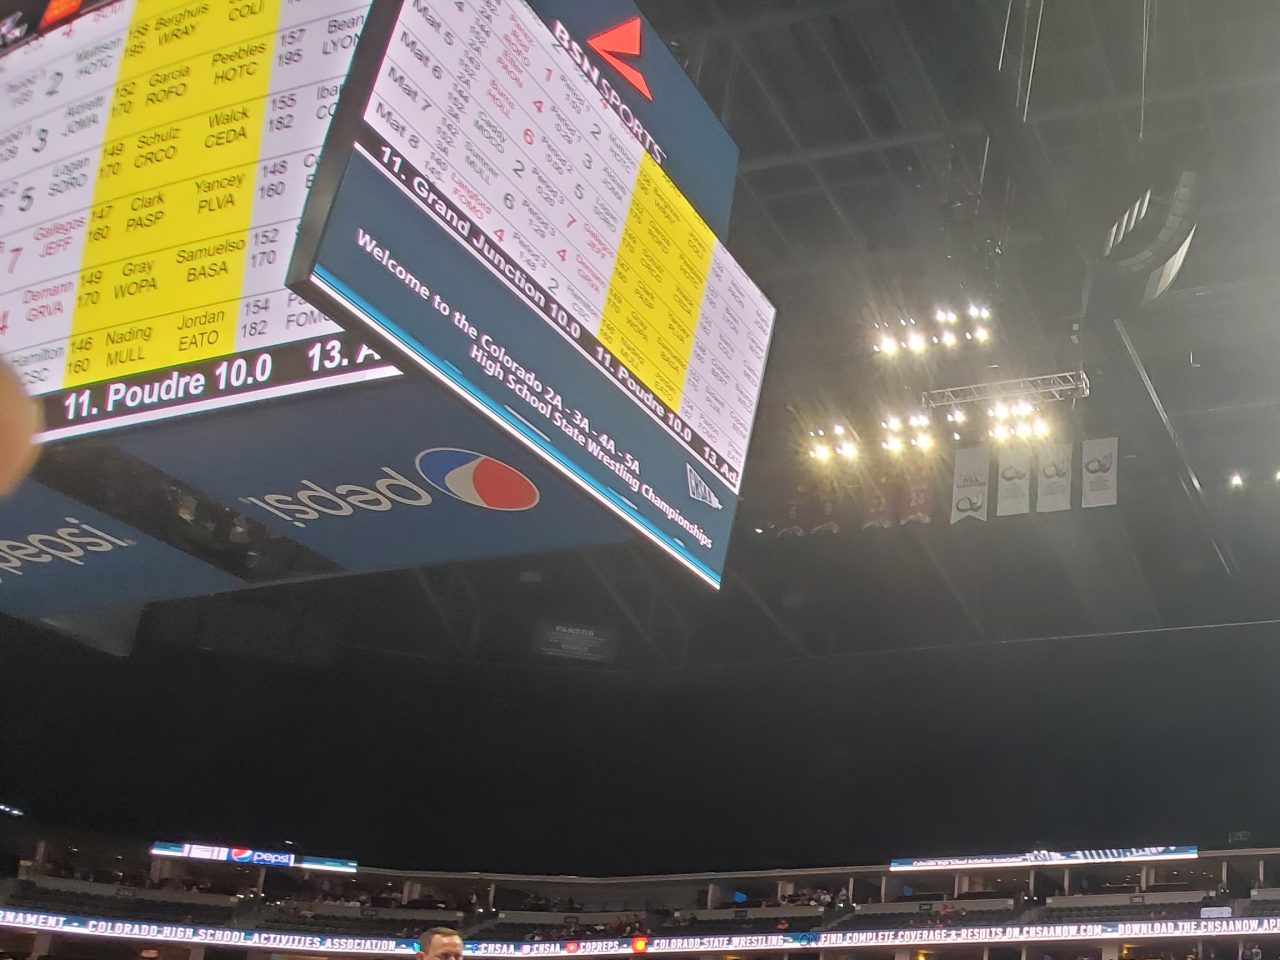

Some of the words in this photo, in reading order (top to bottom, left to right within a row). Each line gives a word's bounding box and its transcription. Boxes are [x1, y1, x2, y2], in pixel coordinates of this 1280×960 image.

[411, 0, 442, 35] Mat
[442, 28, 455, 49] 5
[280, 29, 306, 48] 157
[212, 43, 267, 67] Peebles
[399, 28, 431, 70] Mat
[430, 61, 444, 83] 6
[46, 71, 63, 96] 2
[148, 65, 191, 88] Garcia
[214, 61, 258, 85] HOTC
[145, 82, 188, 107] ROFO
[387, 63, 419, 104] Mat
[419, 96, 432, 118] 7
[209, 106, 250, 129] Walck
[374, 99, 407, 140] Mat
[407, 130, 421, 152] 8
[32, 128, 48, 153] 3
[136, 126, 181, 151] Schulz
[204, 126, 248, 149] CEDA
[521, 123, 536, 149] 6
[134, 145, 178, 169] CRCO
[511, 155, 526, 181] 2
[194, 173, 245, 195] Yancey
[259, 181, 286, 200] 160
[572, 179, 586, 203] 5
[18, 186, 35, 212] 5
[130, 191, 165, 213] Clark
[197, 194, 236, 215] PLVA
[501, 188, 517, 214] 6
[125, 210, 165, 233] PASP
[491, 221, 506, 245] 4
[563, 210, 577, 234] 7
[253, 228, 280, 247] 152
[379, 144, 407, 180] 11.
[413, 176, 471, 236] Grand
[472, 231, 545, 307] Junction
[548, 305, 582, 340] 10.0
[175, 239, 247, 266] Samuelso
[250, 250, 277, 269] 170
[555, 242, 568, 265] 4
[81, 270, 103, 289] 149
[122, 261, 154, 277] Gray
[186, 260, 230, 283] BASA
[113, 277, 158, 300] WOPA
[546, 274, 560, 298] 2
[243, 298, 271, 317] 154
[177, 309, 225, 331] Jordan
[241, 320, 269, 339] 182
[70, 336, 93, 355] 146
[105, 326, 153, 348] Nading
[178, 330, 220, 352] EATO
[106, 347, 146, 368] MULL
[308, 338, 349, 372] 13.
[356, 228, 430, 303] Welcome
[434, 295, 452, 318] to
[455, 309, 479, 341] the
[481, 328, 543, 393] Colorado
[546, 386, 563, 411] 2A
[571, 409, 591, 435] 3A
[598, 431, 617, 456] 4A
[623, 452, 641, 476] 5A
[68, 358, 91, 377] 160
[64, 388, 99, 420] 11.
[106, 371, 205, 412] Poudre
[215, 353, 272, 390] 10.0
[594, 345, 615, 373] 11.
[618, 367, 666, 417] Poudre
[667, 413, 692, 442] 10.0
[470, 344, 504, 384] High
[504, 371, 553, 420] School
[553, 411, 587, 447] State
[587, 433, 640, 493] Wrestling
[641, 481, 714, 549] Championships
[703, 446, 720, 470] 13.
[248, 467, 433, 528] pepsi
[253, 852, 289, 864] pepsi
[88, 920, 158, 937] COLORADO
[163, 926, 193, 940] HIGH
[199, 928, 247, 944] SCHOOL
[252, 931, 321, 949] ACTIVITIES
[325, 936, 397, 952] ASSOCIATION
[821, 933, 843, 945] FIND
[845, 931, 895, 944] COMPLETE
[898, 929, 947, 943] COVERAGE
[960, 926, 1003, 940] RESULTS
[1005, 926, 1020, 938] ON
[1023, 924, 1102, 938] CHSAANOW.COM
[1118, 921, 1175, 936] DOWNLOAD
[1177, 921, 1198, 934] THE
[1201, 919, 1259, 933] CHSAANOW
[481, 943, 516, 955] CHSAA
[534, 942, 561, 954] CHSAA
[580, 940, 619, 953] COPREPS
[653, 938, 700, 951] COLORADO
[703, 937, 729, 948] STATE
[731, 935, 784, 947] WRESTLING
